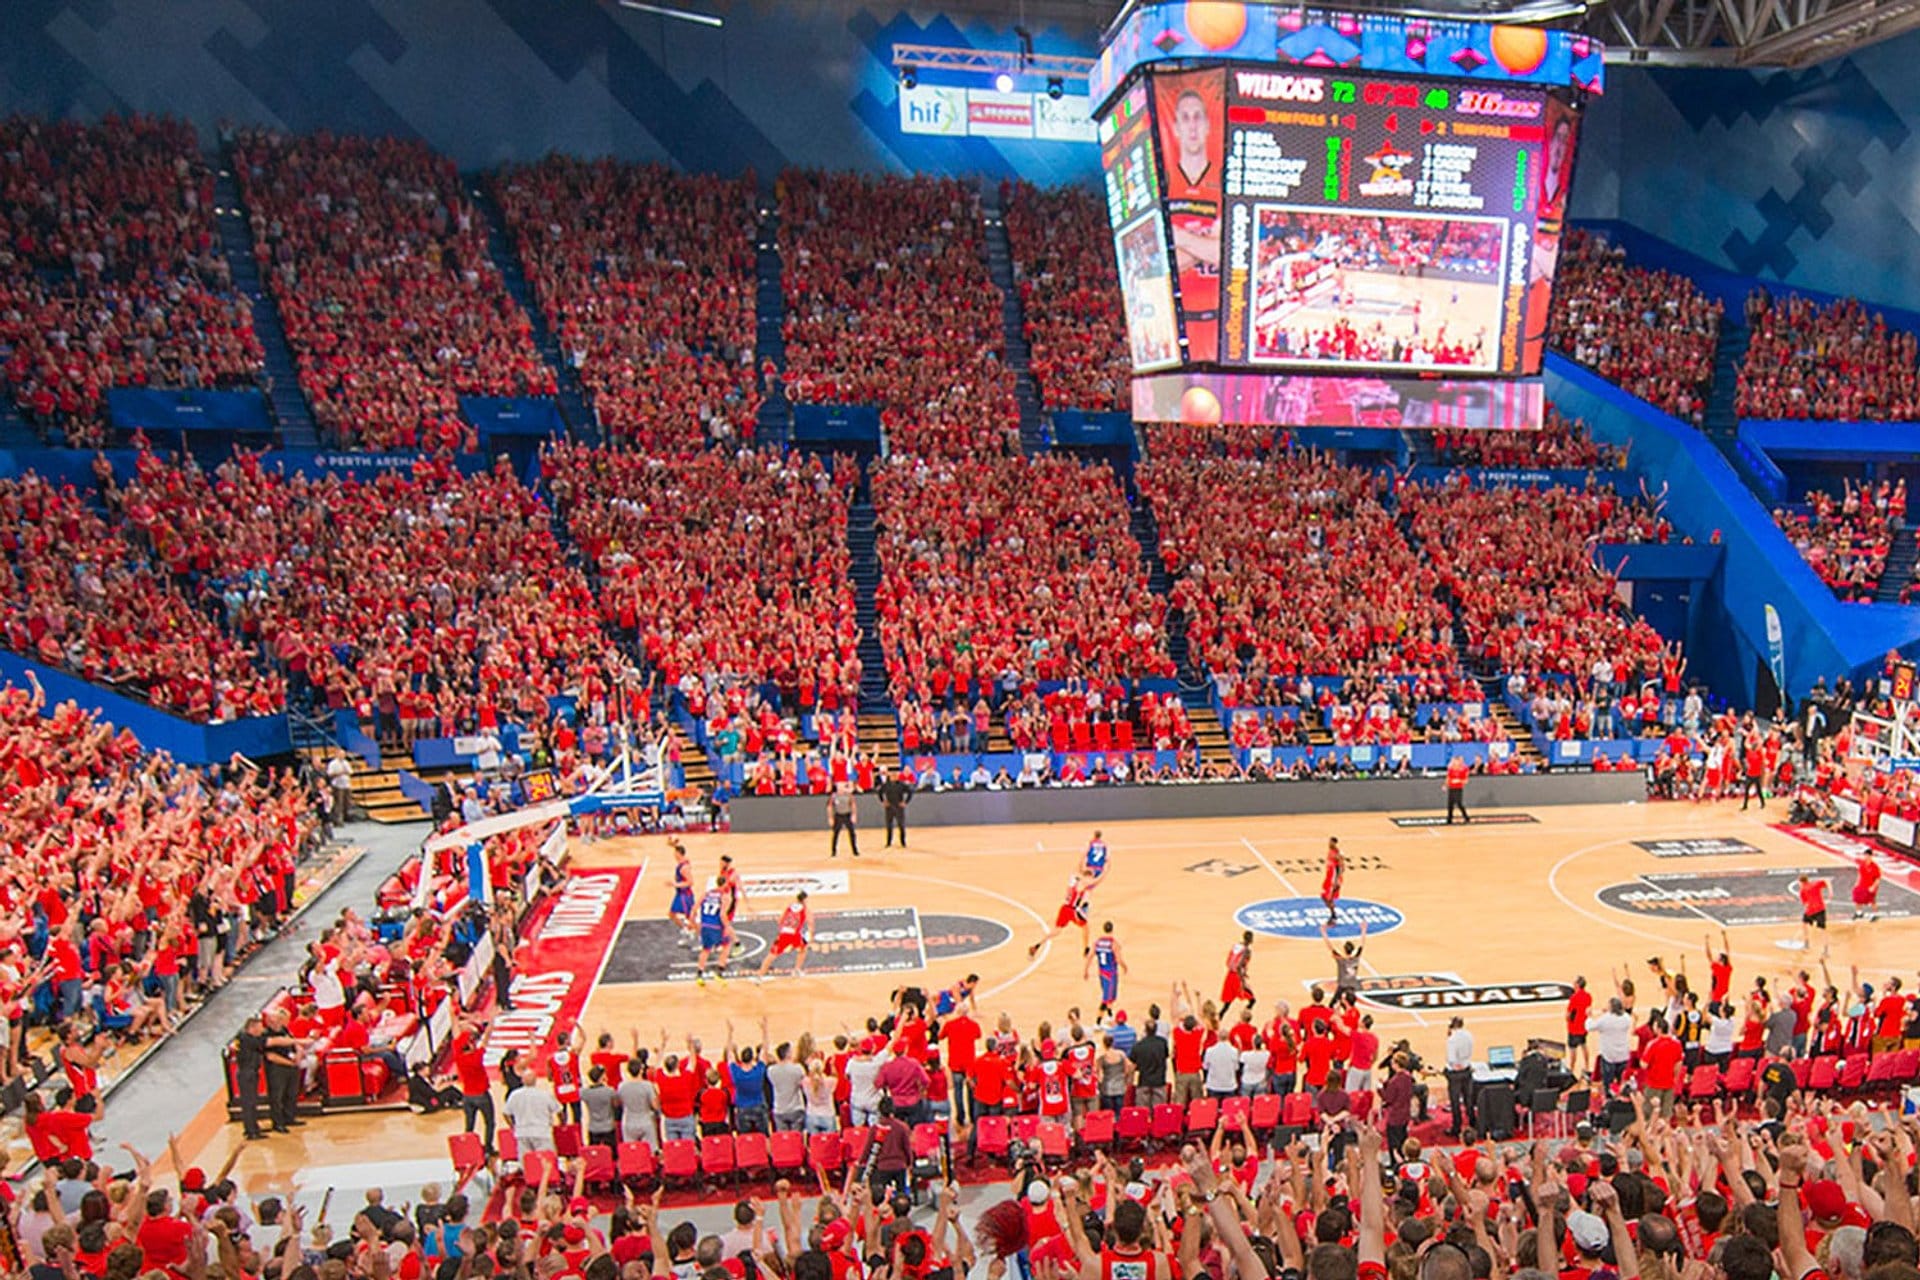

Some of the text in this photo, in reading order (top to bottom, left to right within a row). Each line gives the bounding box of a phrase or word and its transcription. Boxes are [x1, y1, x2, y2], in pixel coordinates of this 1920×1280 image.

[1236, 72, 1324, 102] WILDCATS
[1332, 81, 1356, 103] 72
[909, 101, 942, 123] hif
[538, 873, 620, 940] WILDCATS
[703, 902, 721, 915] 17
[1400, 984, 1564, 1007] FINALS
